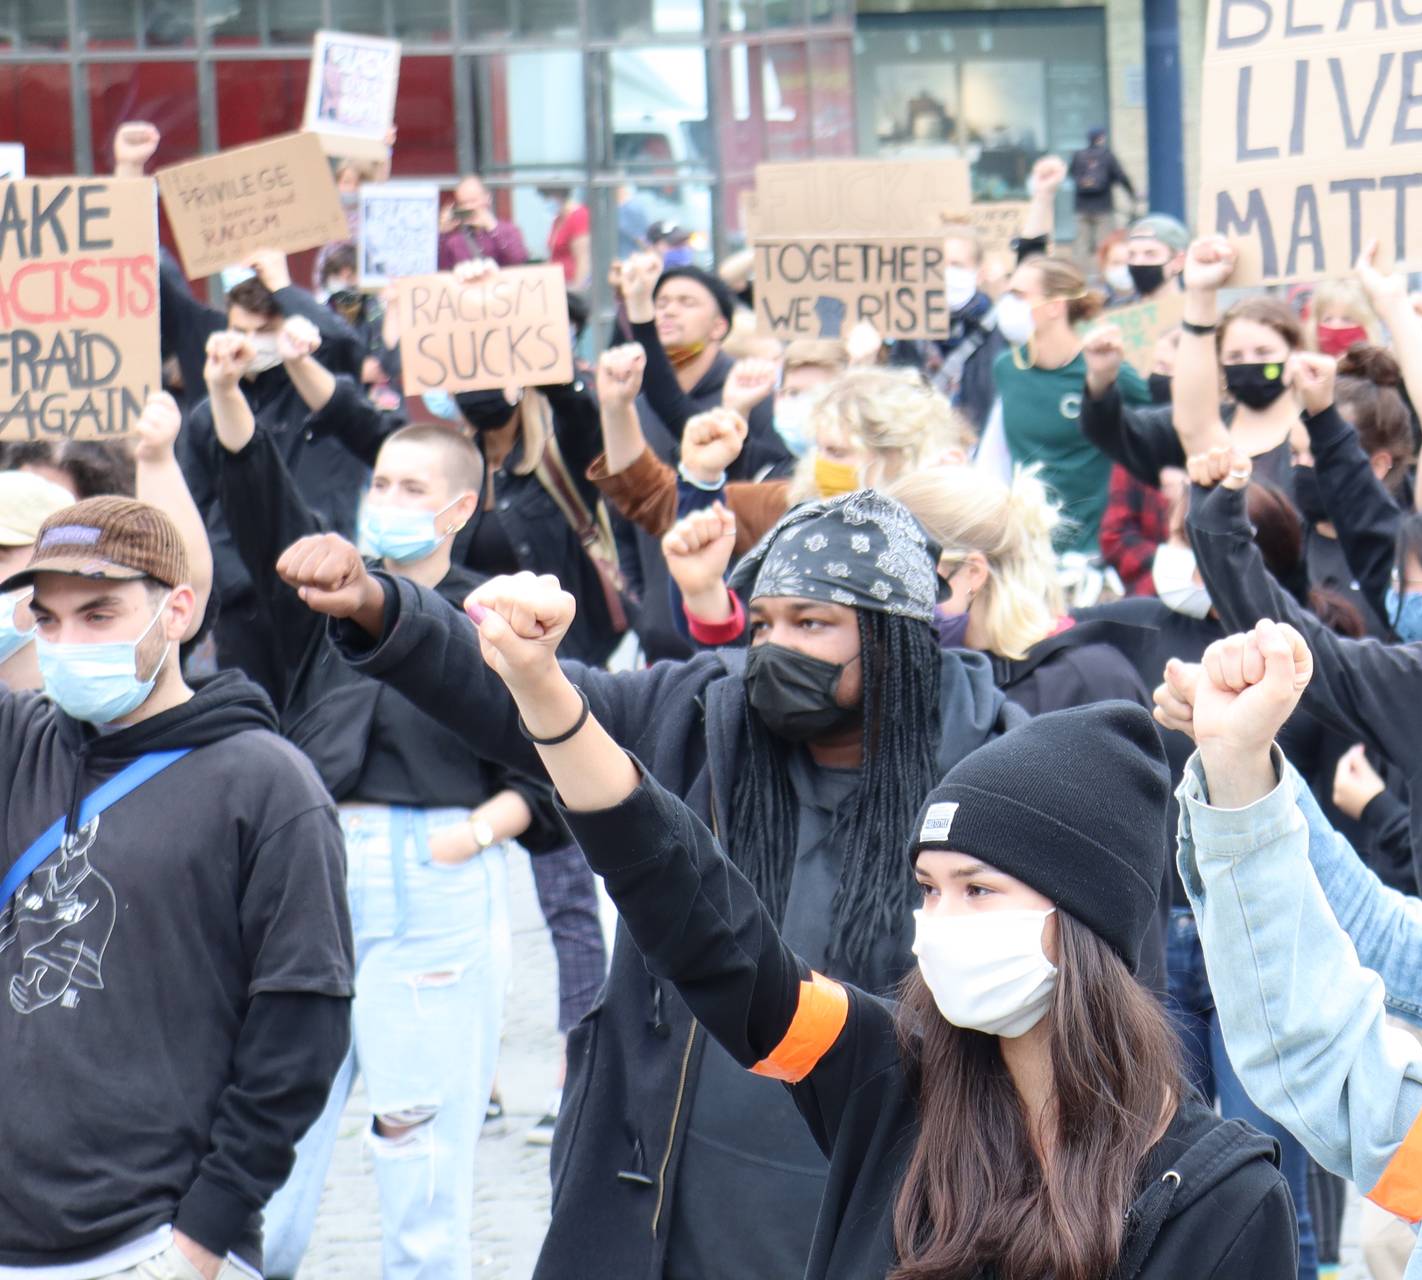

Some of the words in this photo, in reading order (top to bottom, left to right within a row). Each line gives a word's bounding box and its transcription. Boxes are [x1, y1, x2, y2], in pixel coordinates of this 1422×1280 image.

[178, 163, 295, 211] PRIVILEGE
[754, 242, 944, 283] TOGETHER
[411, 279, 549, 328] RACISM
[762, 297, 813, 332] WE
[857, 287, 949, 334] RISE
[416, 323, 560, 388] SUCKS
